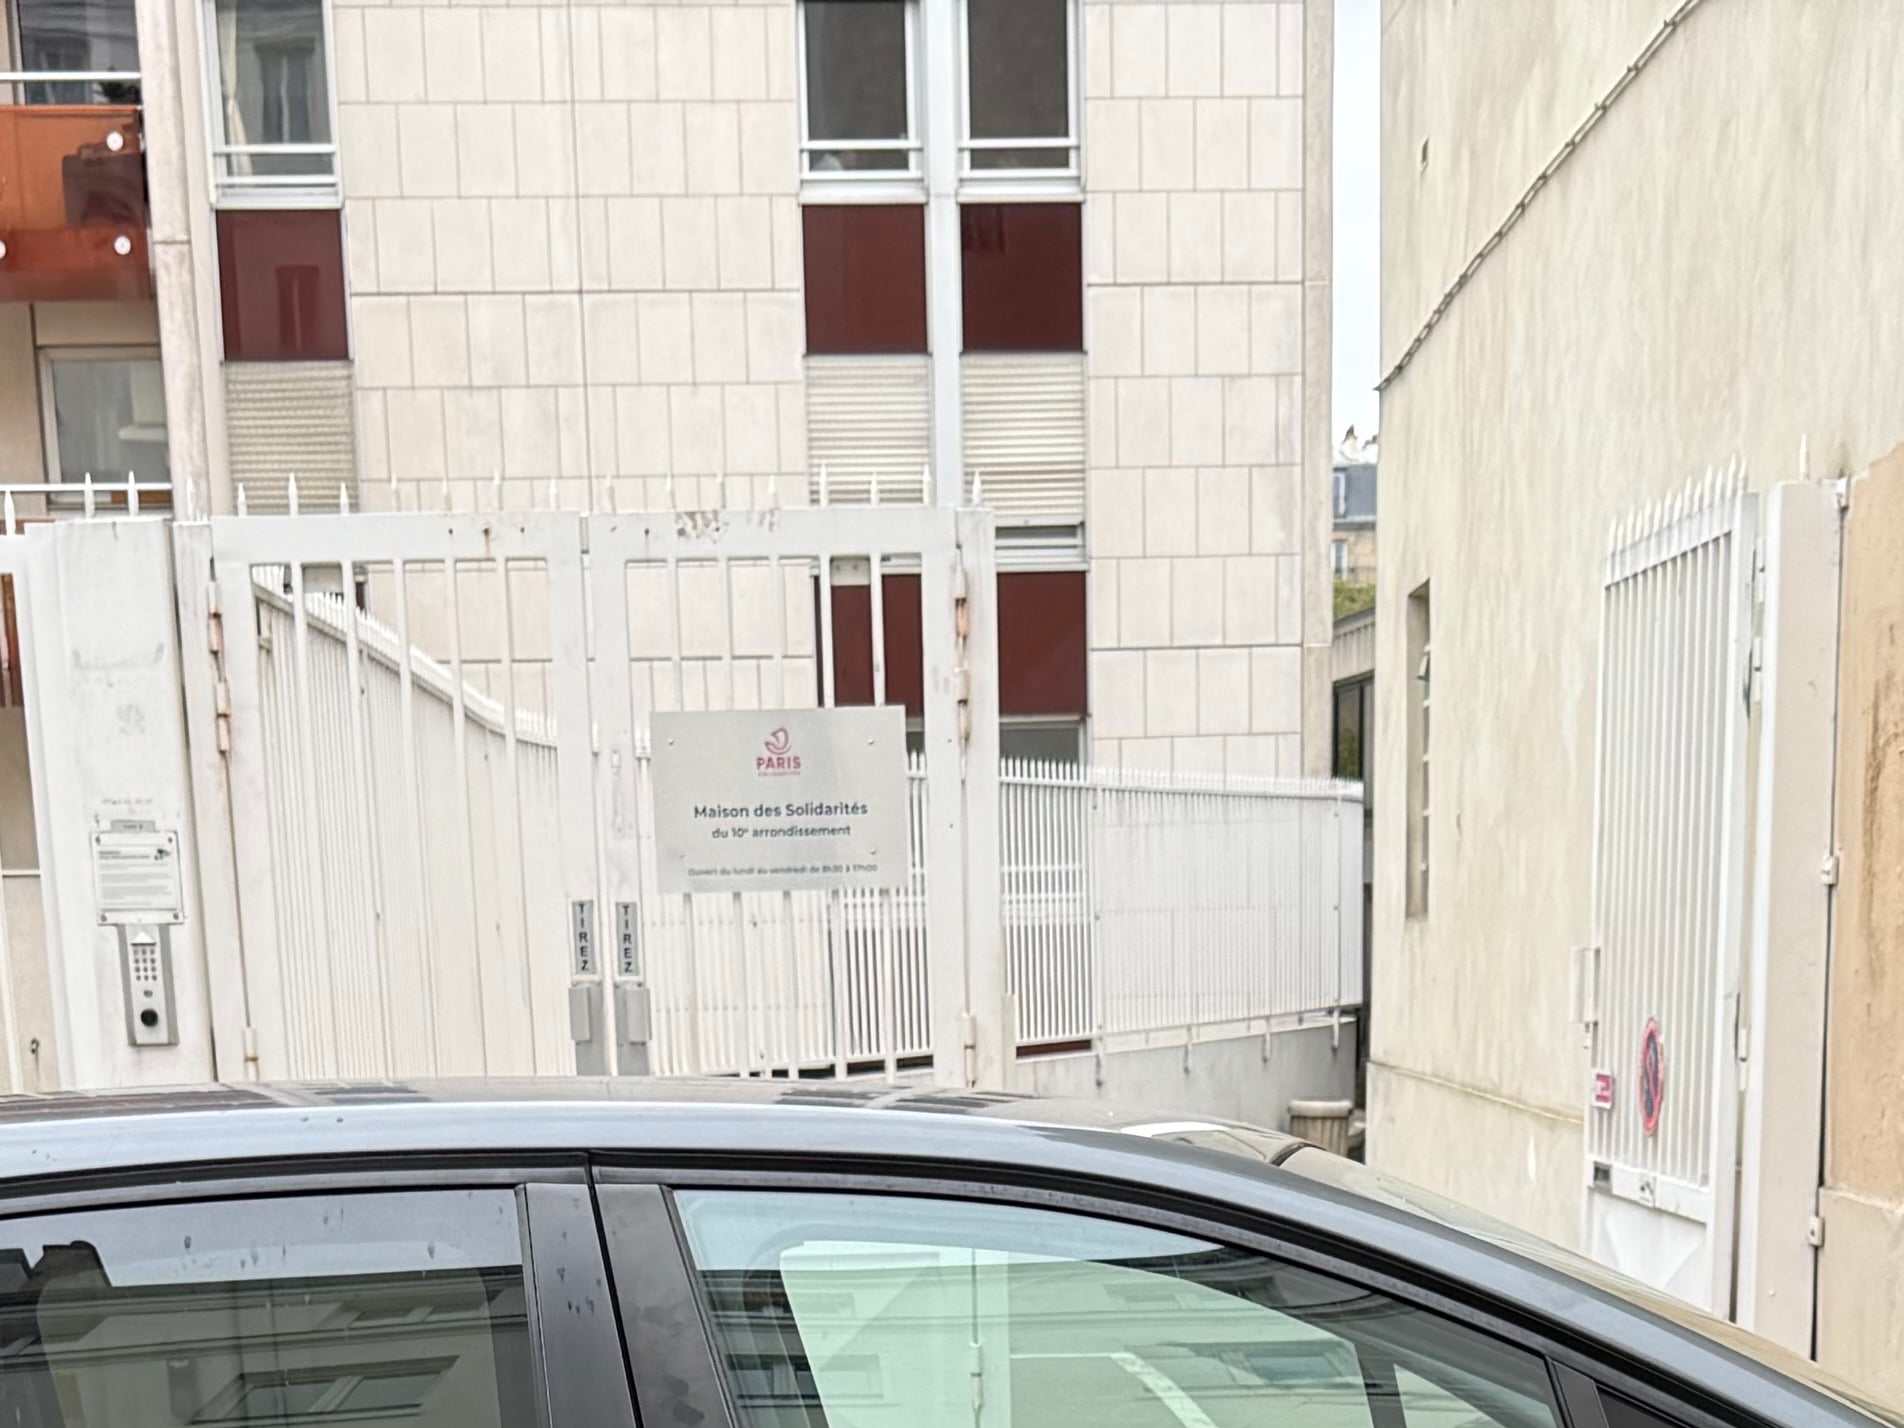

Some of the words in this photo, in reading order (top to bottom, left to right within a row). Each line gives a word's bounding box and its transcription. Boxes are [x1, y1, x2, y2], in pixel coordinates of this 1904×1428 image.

[756, 756, 801, 770] PARIS
[694, 804, 750, 819] Maison
[754, 804, 781, 818] des
[785, 802, 869, 817] Solidarités
[712, 828, 728, 839] du
[752, 825, 851, 838] arrondissement
[578, 902, 590, 971] TIREZ
[622, 904, 634, 973] TIREZ
